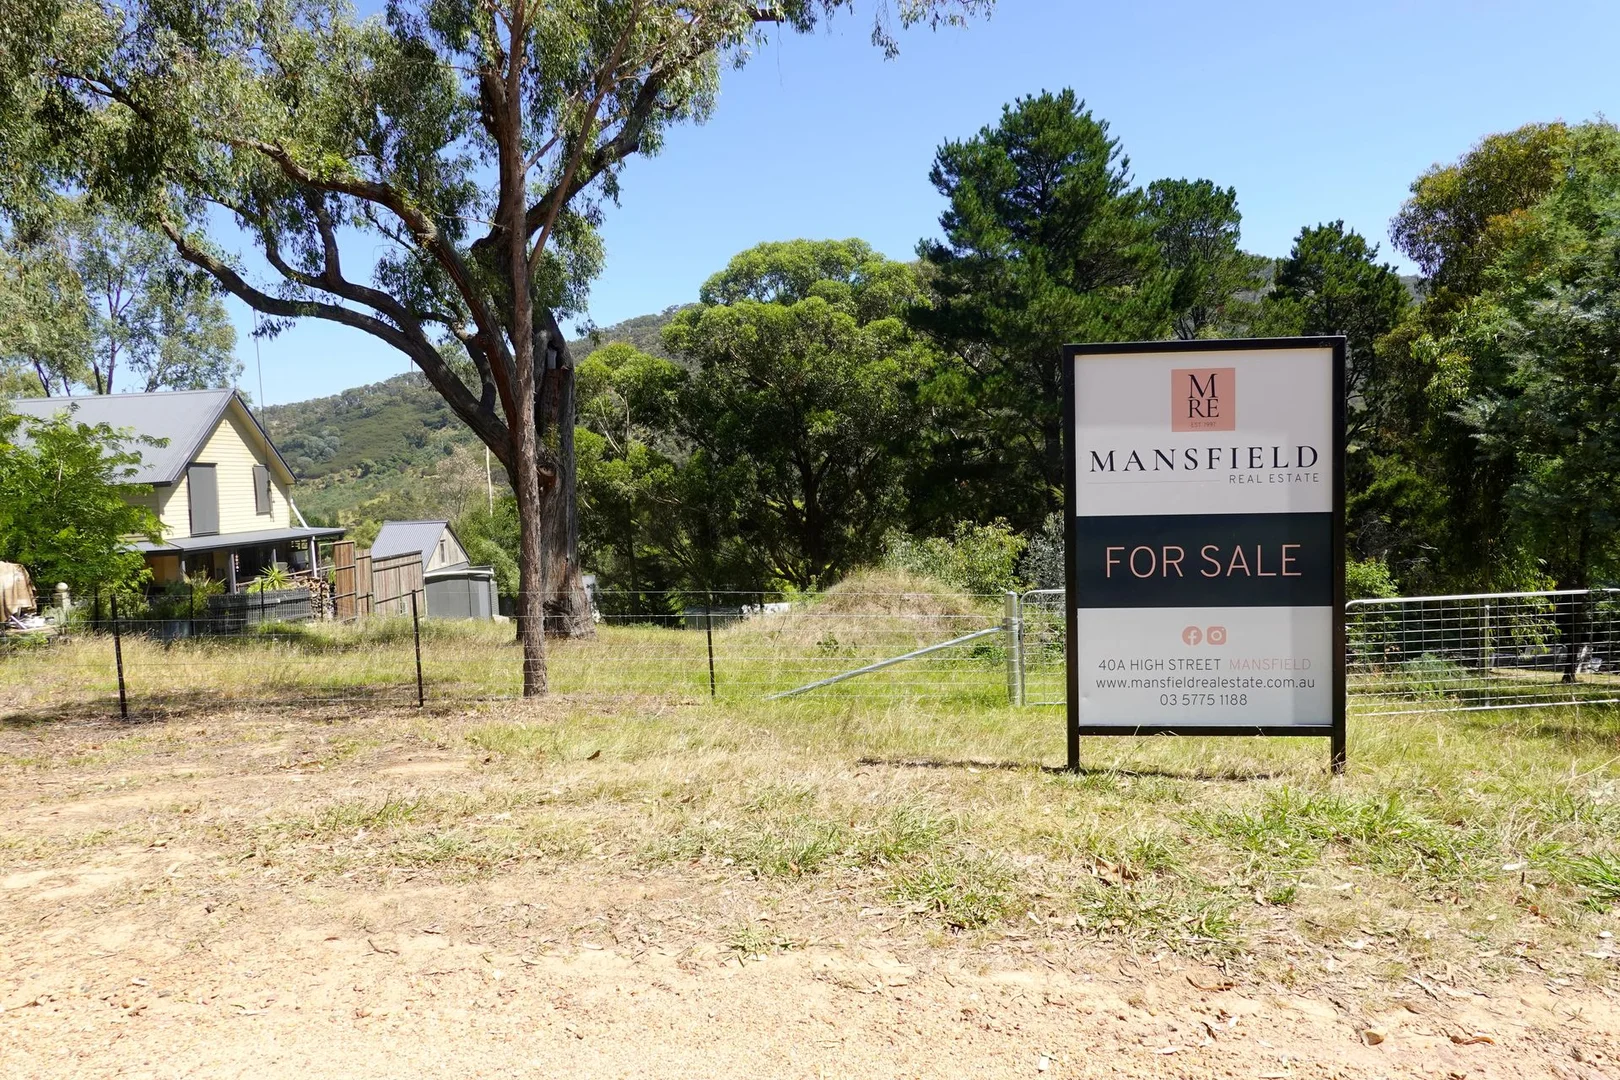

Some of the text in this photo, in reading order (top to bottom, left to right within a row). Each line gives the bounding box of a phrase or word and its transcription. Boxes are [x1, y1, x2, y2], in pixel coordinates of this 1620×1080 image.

[1188, 374, 1218, 398] M
[1188, 399, 1220, 418] RE
[1090, 446, 1318, 472] MANSFIELD
[1230, 473, 1319, 484] REAL ESTATE
[1106, 544, 1302, 578] FOR SALE
[1098, 658, 1311, 670] 40A HIGH STREET MANSFIELD
[1096, 676, 1315, 688] www.mansfieldrealestate.com.au
[1160, 694, 1248, 706] 03 5775 1188
